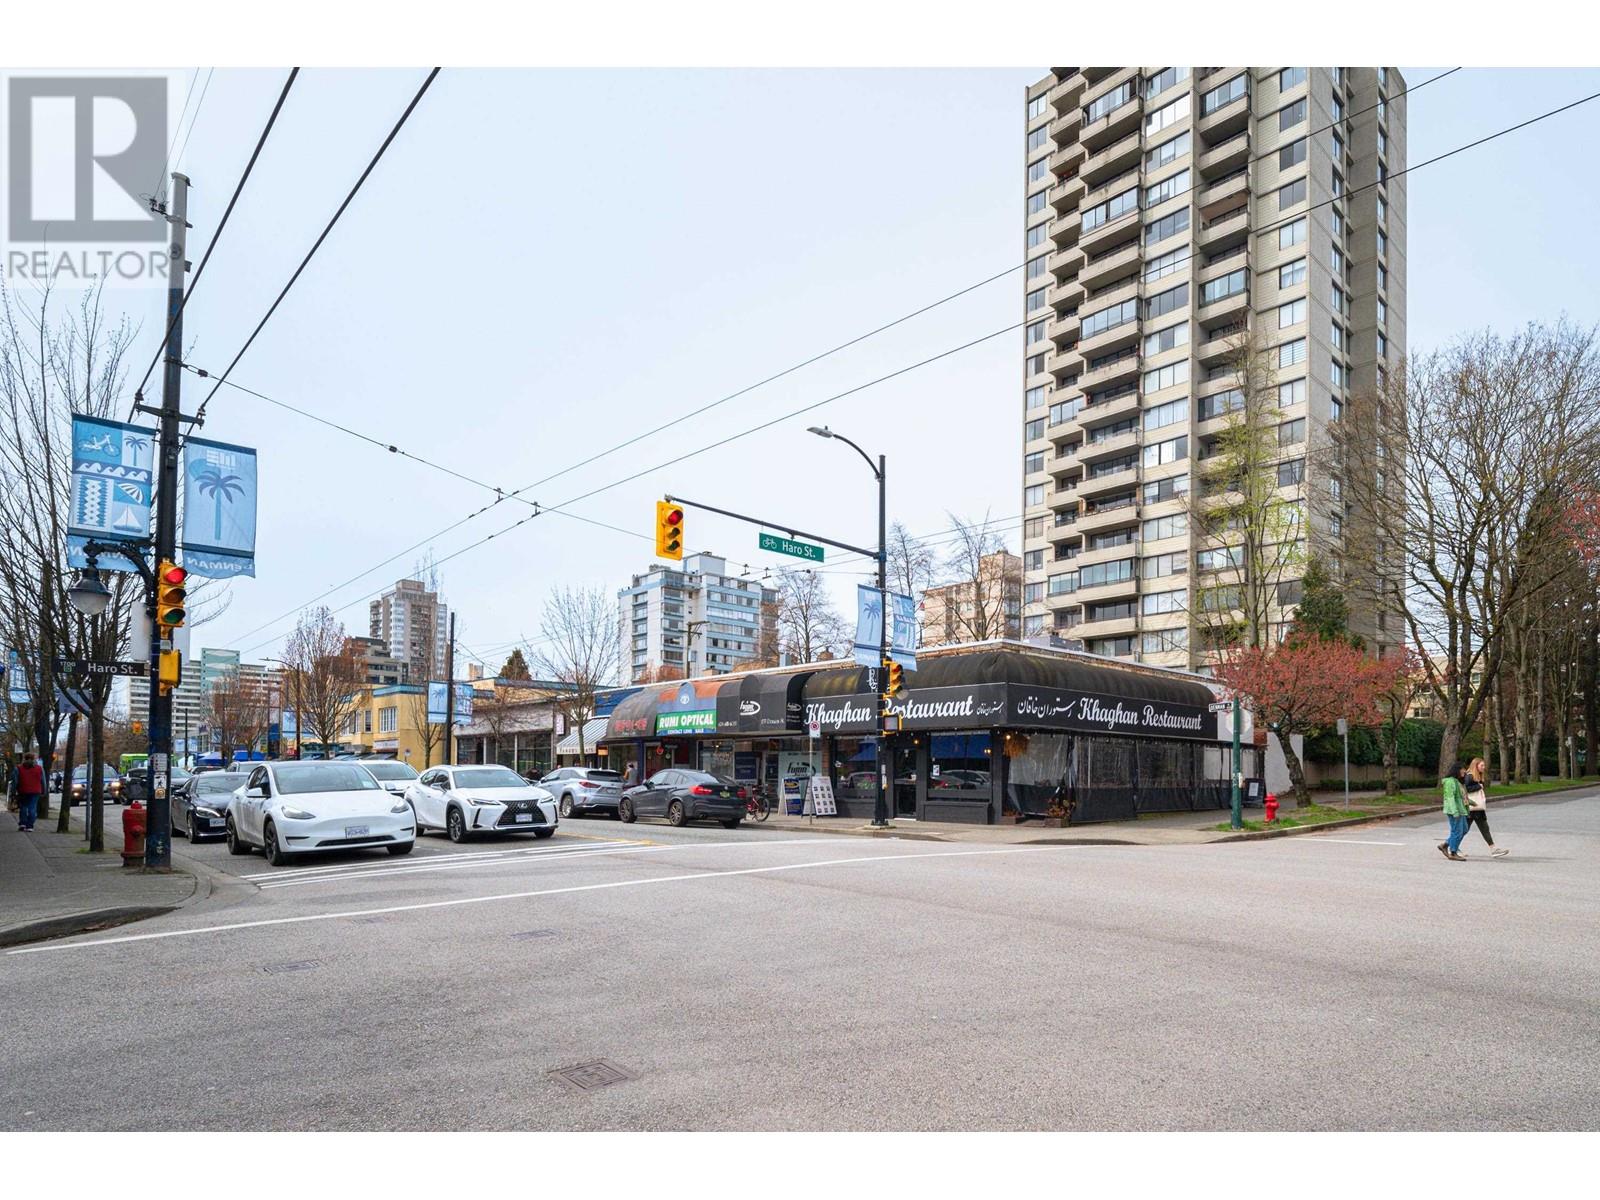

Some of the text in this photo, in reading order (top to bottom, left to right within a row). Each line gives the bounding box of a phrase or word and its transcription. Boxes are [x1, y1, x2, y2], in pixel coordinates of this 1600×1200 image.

[782, 540, 816, 558] Haro St.
[88, 663, 138, 674] Haro St.
[803, 701, 872, 730] Khaghan
[1037, 697, 1076, 719] رستوران
[1077, 697, 1202, 730] Khaghan Restaurant
[659, 716, 679, 729] RUMI
[680, 713, 714, 727] OPTICAL
